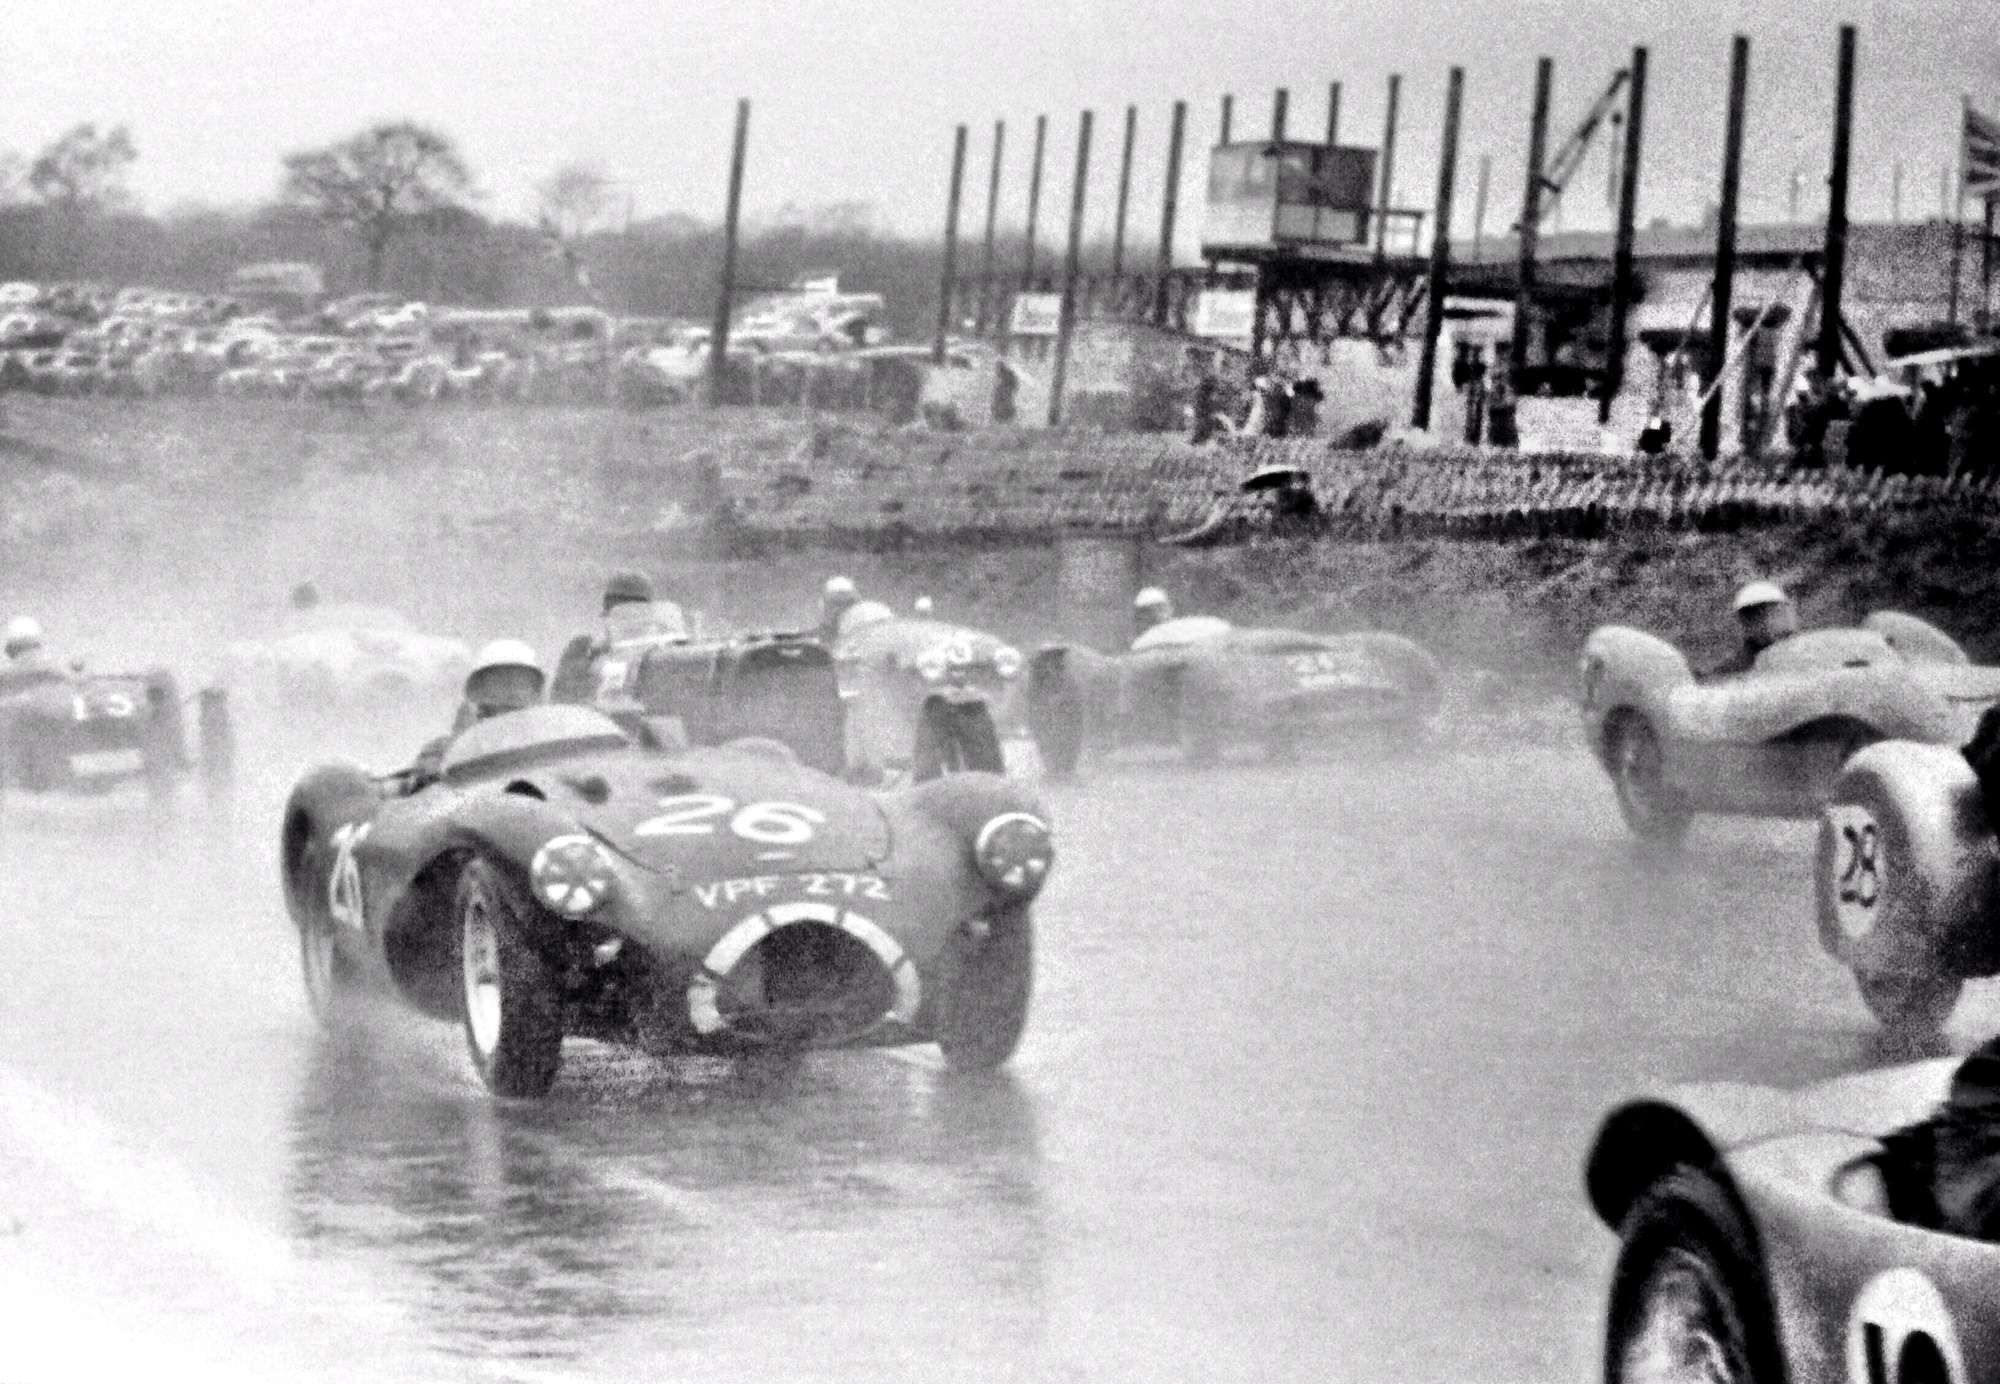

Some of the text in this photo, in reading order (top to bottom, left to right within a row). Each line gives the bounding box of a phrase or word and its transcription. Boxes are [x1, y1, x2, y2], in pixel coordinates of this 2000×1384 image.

[634, 793, 825, 843] 26
[695, 872, 892, 907] VPF 272
